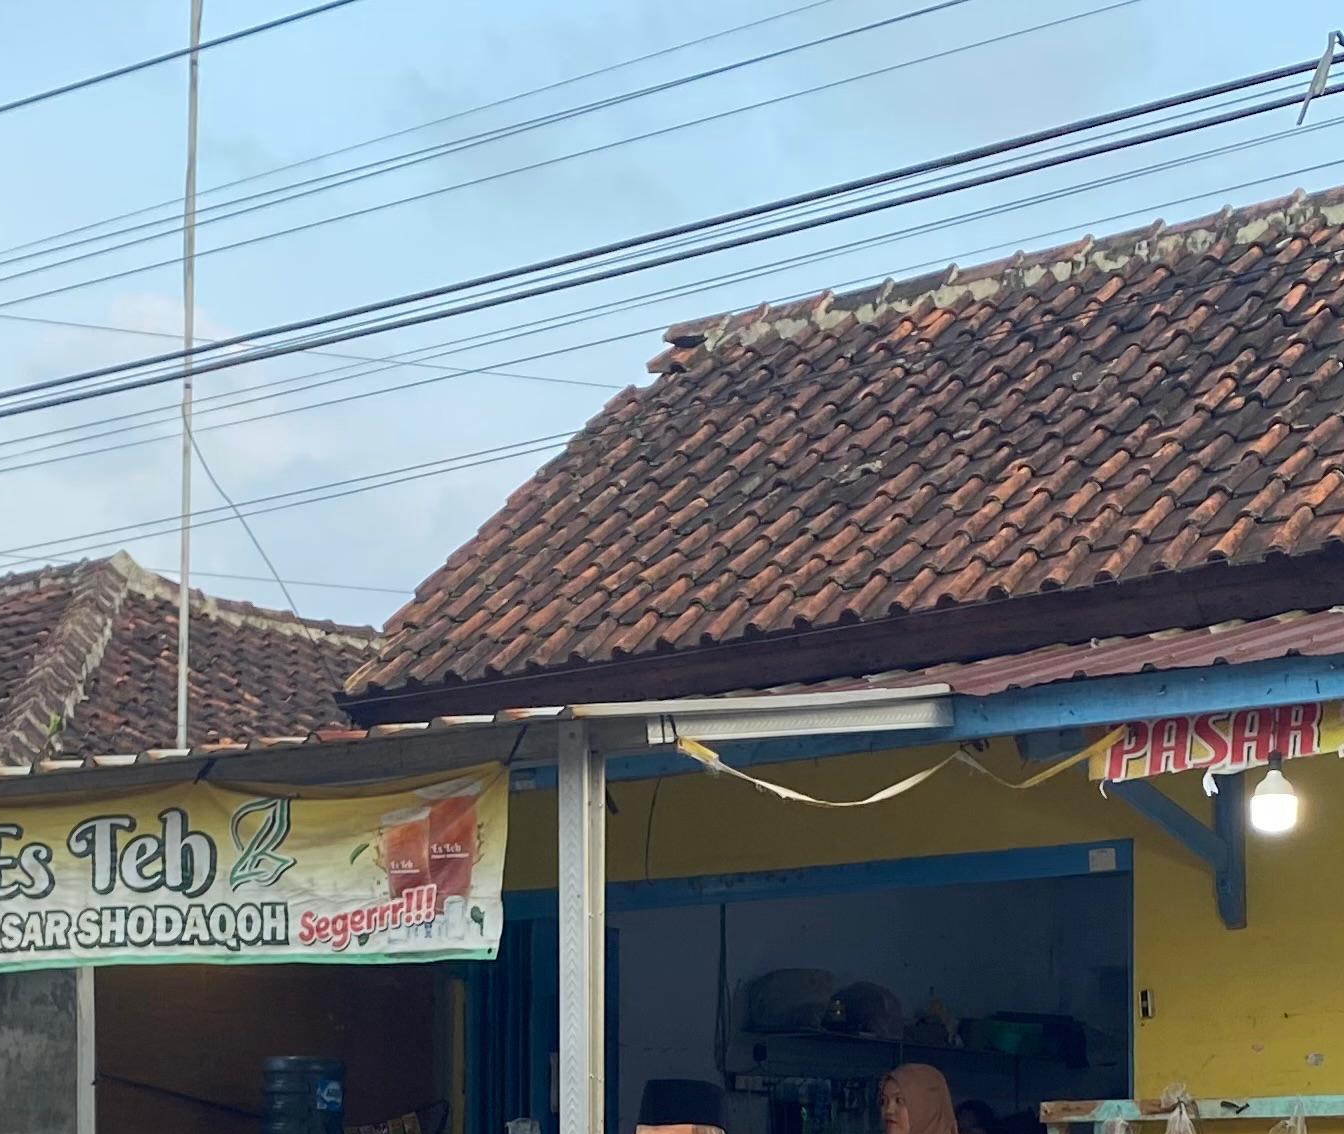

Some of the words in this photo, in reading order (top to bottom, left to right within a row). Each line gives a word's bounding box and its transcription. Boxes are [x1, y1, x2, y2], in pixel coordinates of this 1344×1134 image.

[1106, 701, 1323, 783] PASAR
[67, 808, 218, 899] Teh
[71, 902, 290, 951] SHODAQOH
[298, 883, 438, 951] Segerrr!!!
